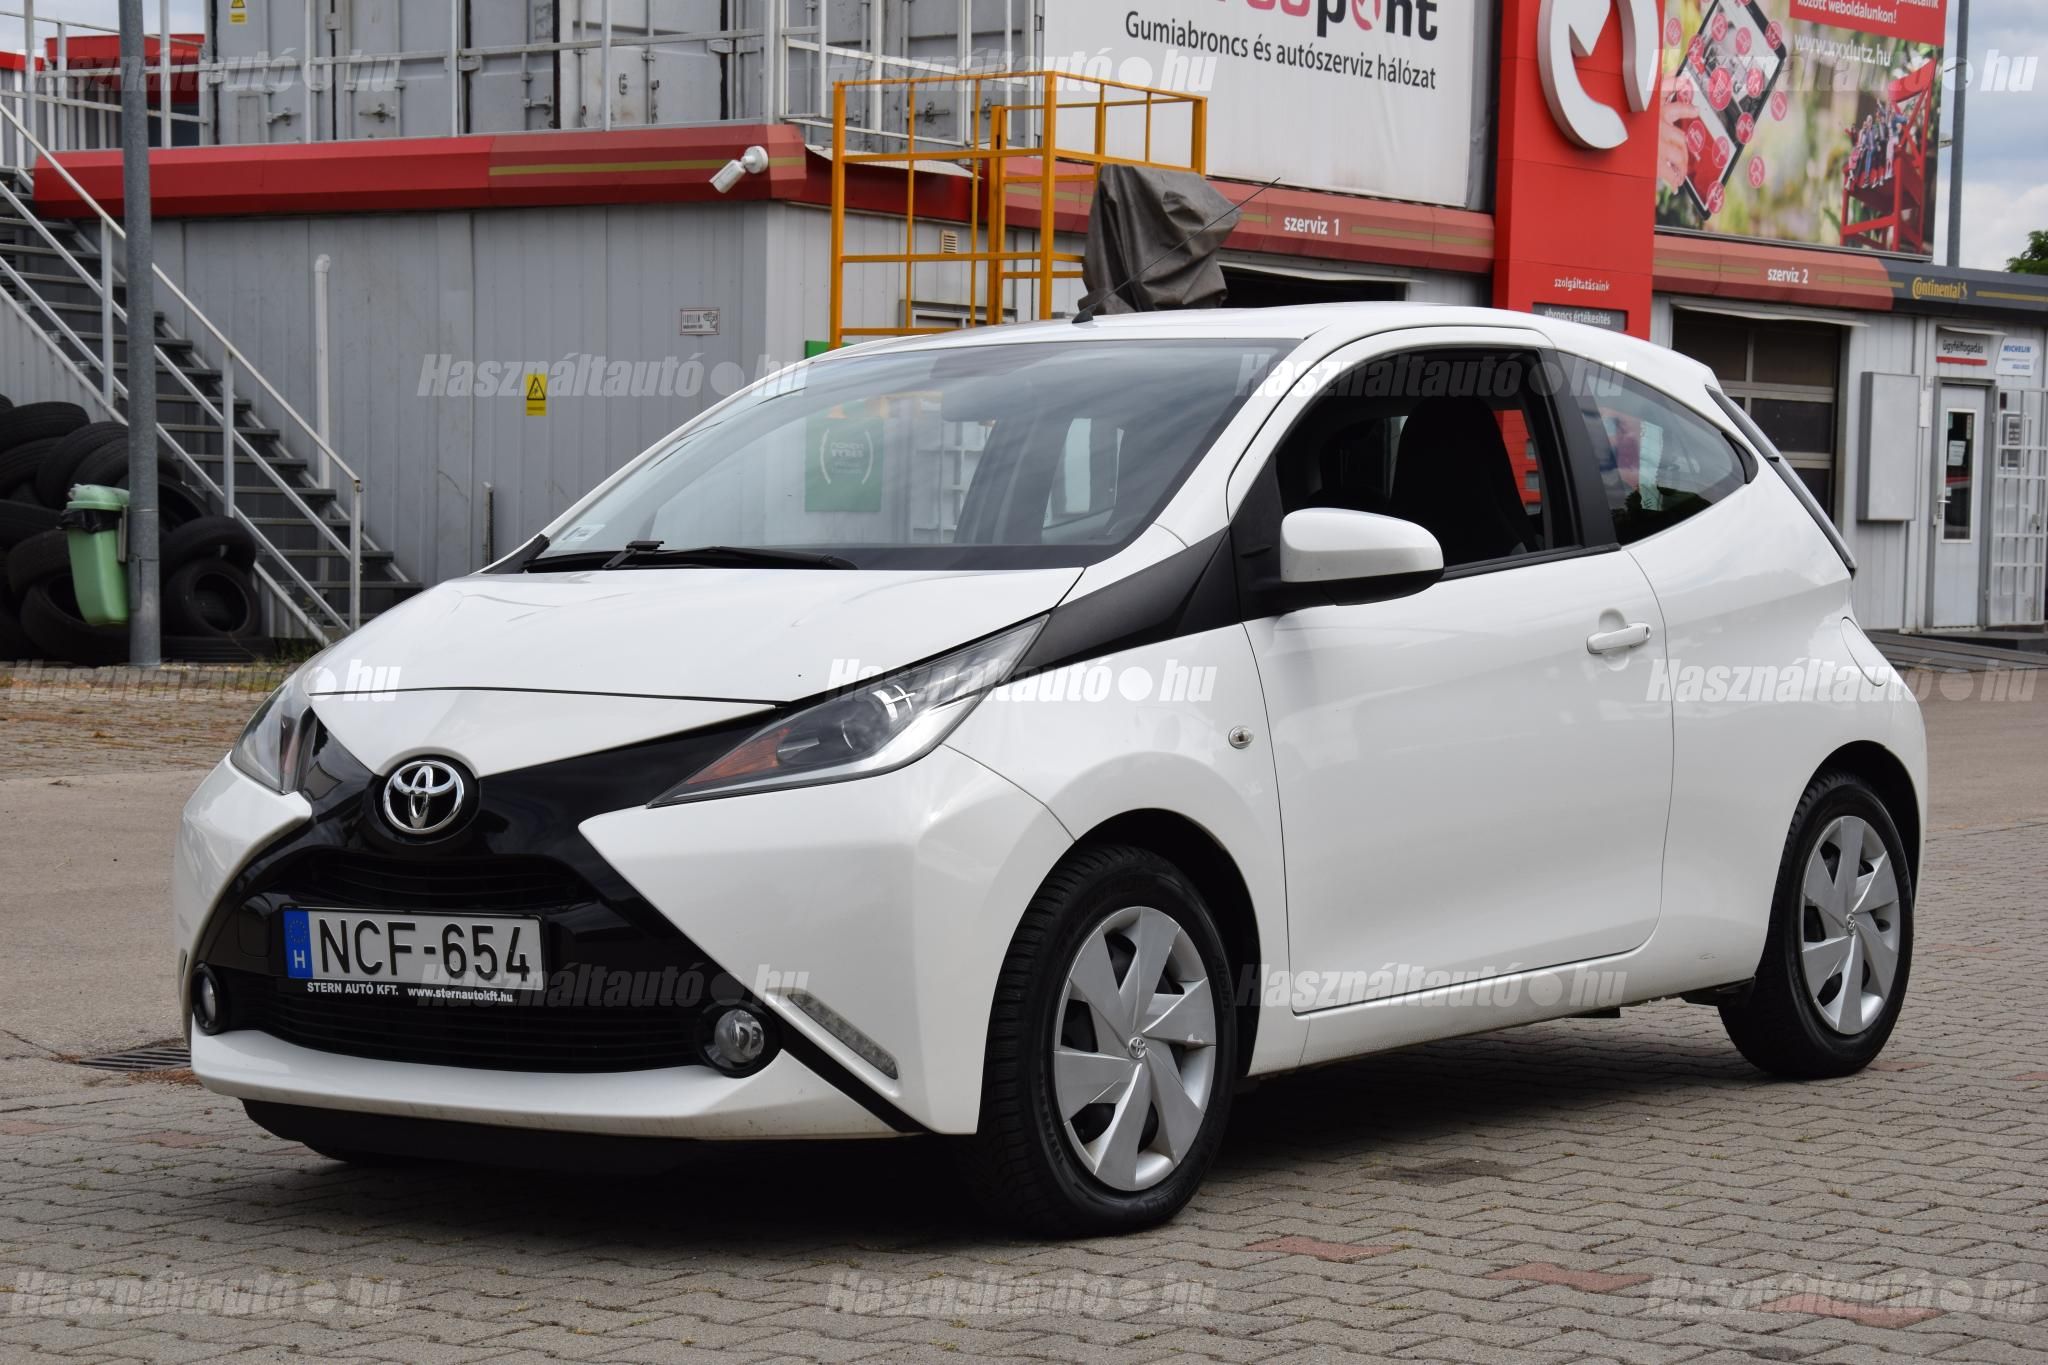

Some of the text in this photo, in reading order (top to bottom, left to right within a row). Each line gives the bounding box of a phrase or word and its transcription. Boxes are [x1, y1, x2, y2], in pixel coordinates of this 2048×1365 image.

[1828, 0, 1897, 24] weboldalunkon!
[1126, 11, 1436, 90] Gumiabroncs és autószerviz hálózat
[1794, 34, 1891, 67] www.xxxlutz.hu
[1284, 215, 1340, 236] szerviz 1
[1767, 266, 1809, 284] szerviz 2
[1912, 276, 1962, 299] Continental
[294, 949, 306, 969] H
[318, 917, 531, 982] NCF-654
[307, 981, 514, 1003] STERN AUTÓ KFT. www.sternautokft.hu
